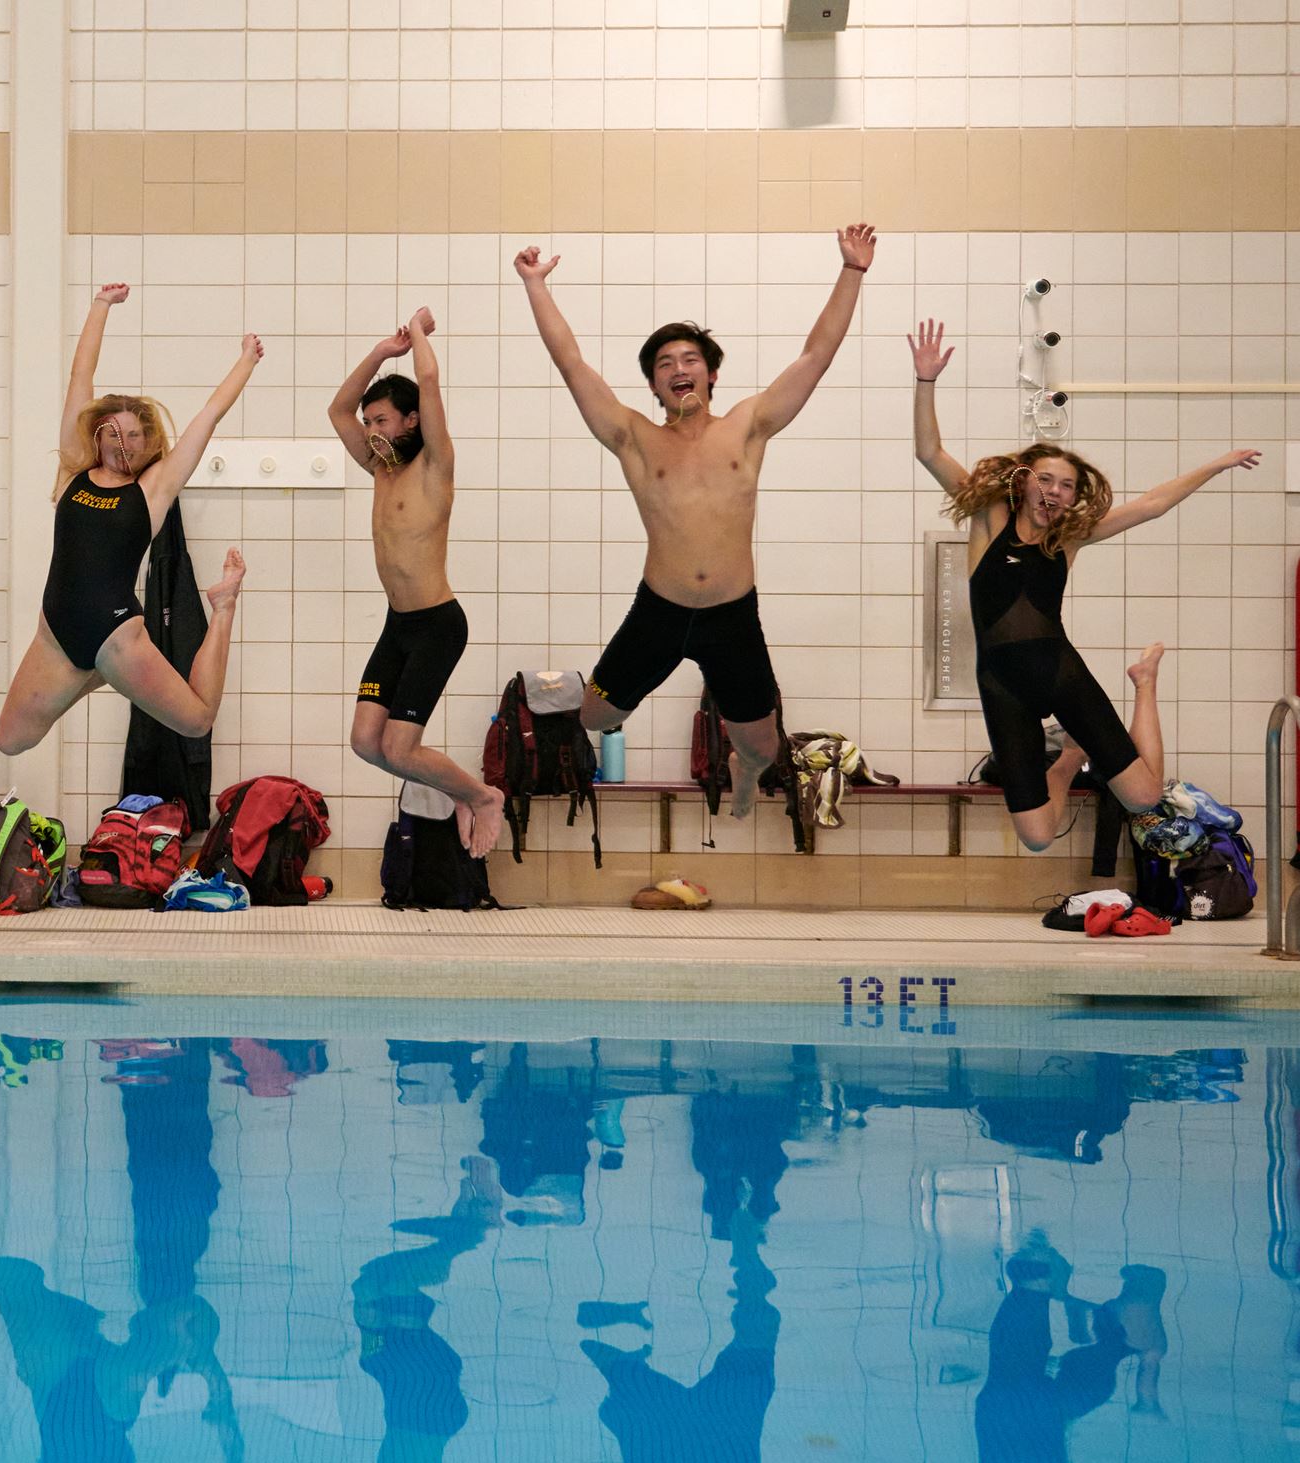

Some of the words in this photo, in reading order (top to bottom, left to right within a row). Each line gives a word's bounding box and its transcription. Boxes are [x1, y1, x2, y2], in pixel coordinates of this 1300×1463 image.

[71, 495, 118, 509] CARLISLE
[77, 490, 121, 504] CONCORD
[942, 590, 951, 692] EXTINGUISHER
[359, 682, 380, 690] CORD
